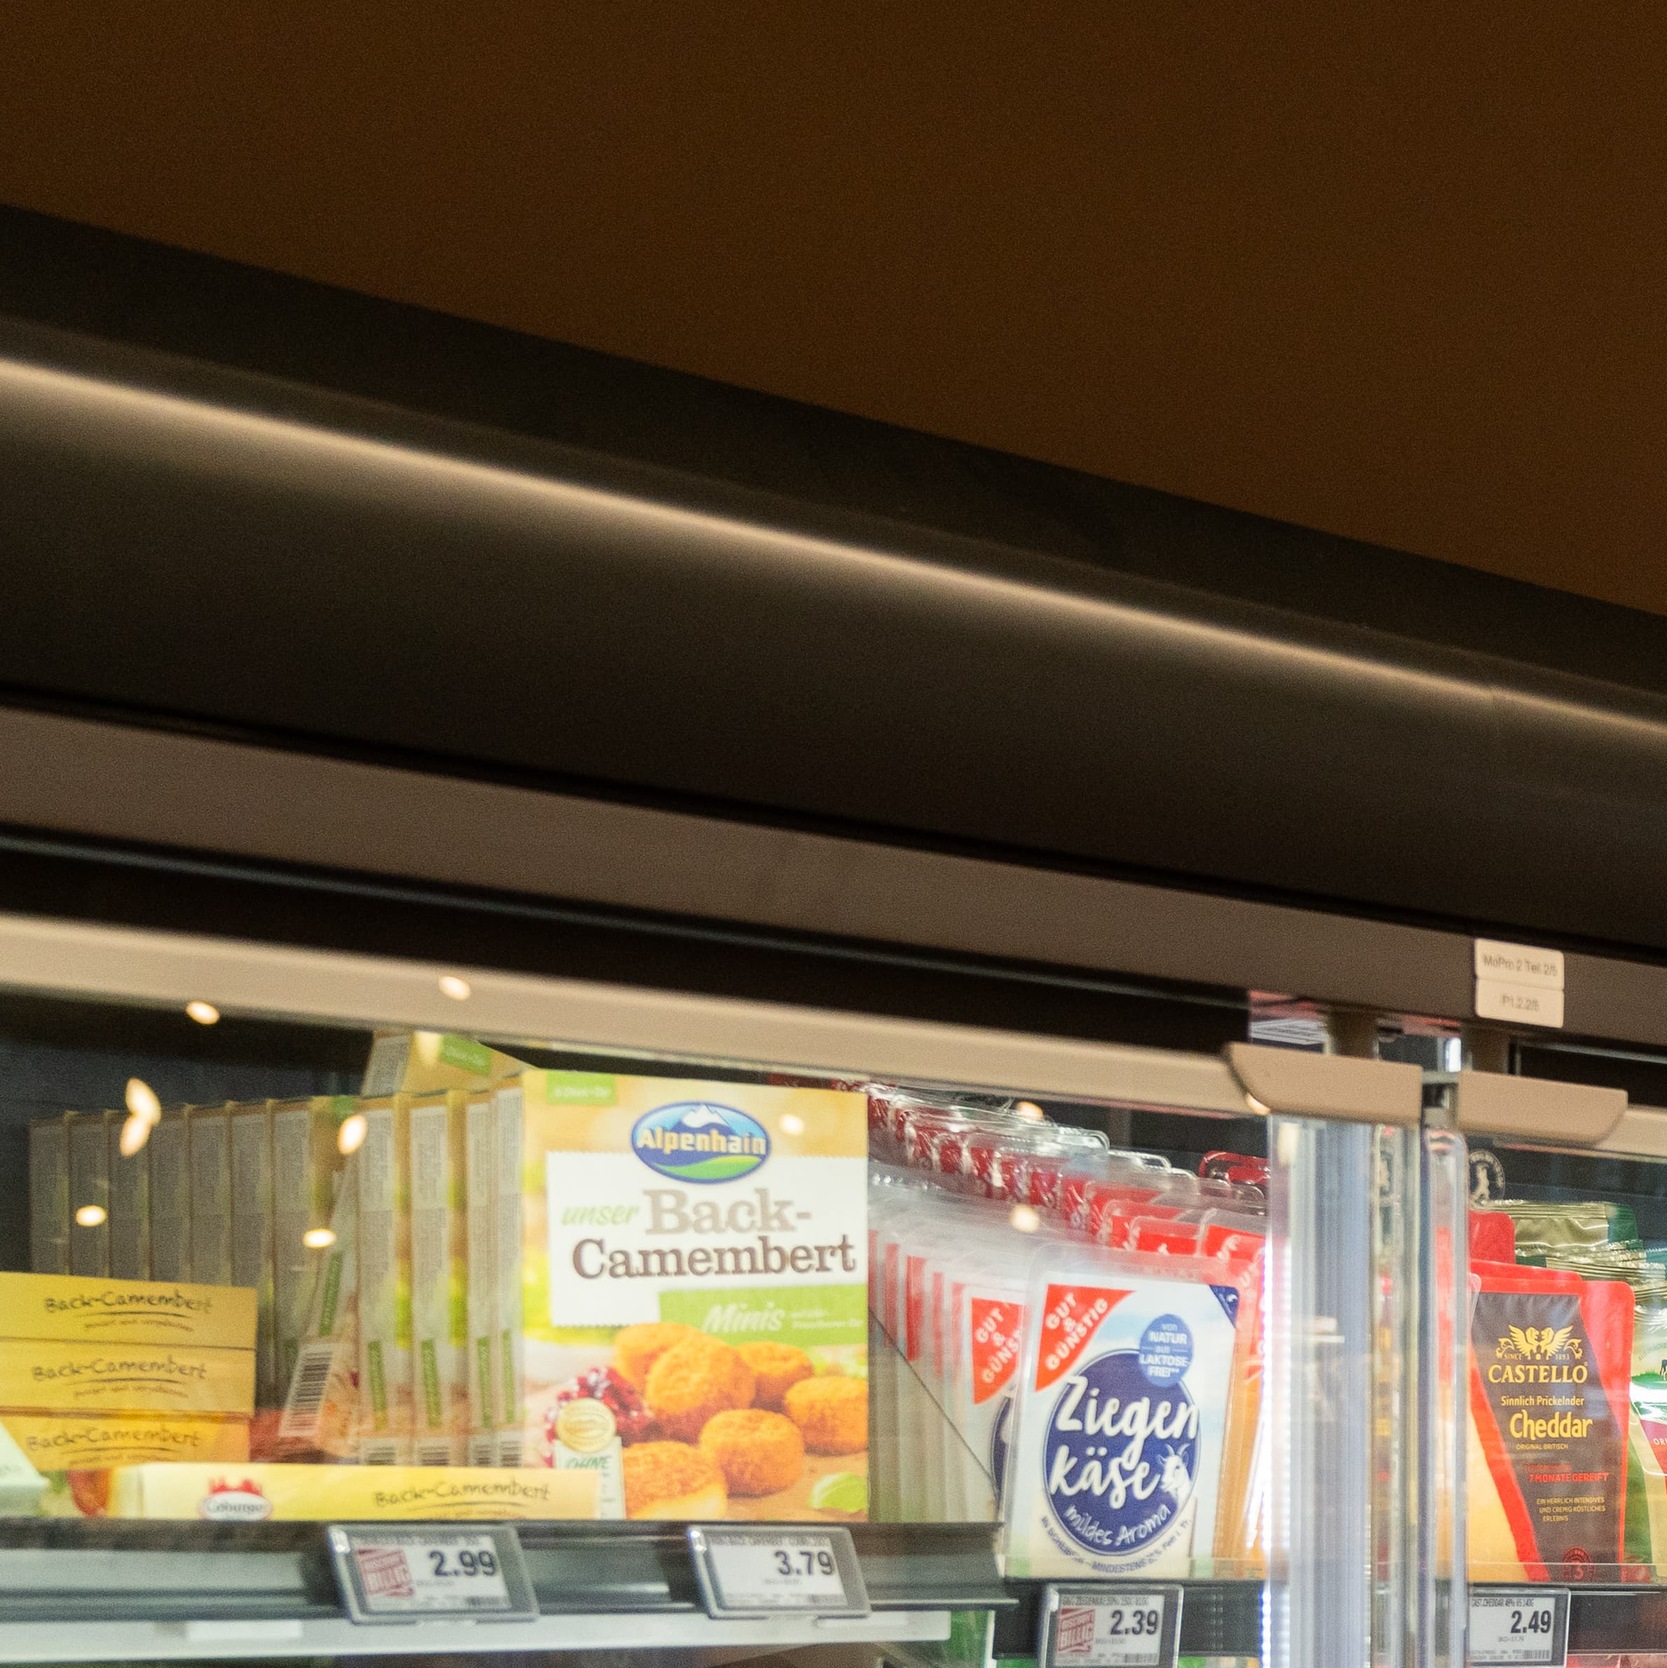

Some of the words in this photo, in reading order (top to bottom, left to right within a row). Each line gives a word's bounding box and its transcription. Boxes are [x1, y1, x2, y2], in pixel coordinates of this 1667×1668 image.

[637, 1124, 767, 1156] Alpenhain
[561, 1203, 640, 1226] unser
[644, 1188, 812, 1235] Back-
[572, 1234, 857, 1278] Camembert
[701, 1302, 785, 1332] Minis
[1044, 1293, 1078, 1330] GUT
[1045, 1297, 1109, 1371] GÜNSTIG
[1149, 1330, 1187, 1344] NATUR
[1488, 1365, 1588, 1383] CASTELLO
[1501, 1396, 1534, 1406] Sinnlich
[1536, 1396, 1584, 1407] Prickelnder
[1056, 1374, 1199, 1472] Ziegen
[1509, 1410, 1593, 1439] Cheddar
[1049, 1445, 1160, 1509] käse
[1535, 1473, 1570, 1482] MONATE
[430, 1550, 497, 1578] 2.99
[775, 1549, 834, 1577] 3.79
[1110, 1610, 1159, 1635] 2.39
[1511, 1610, 1551, 1634] 2.49
